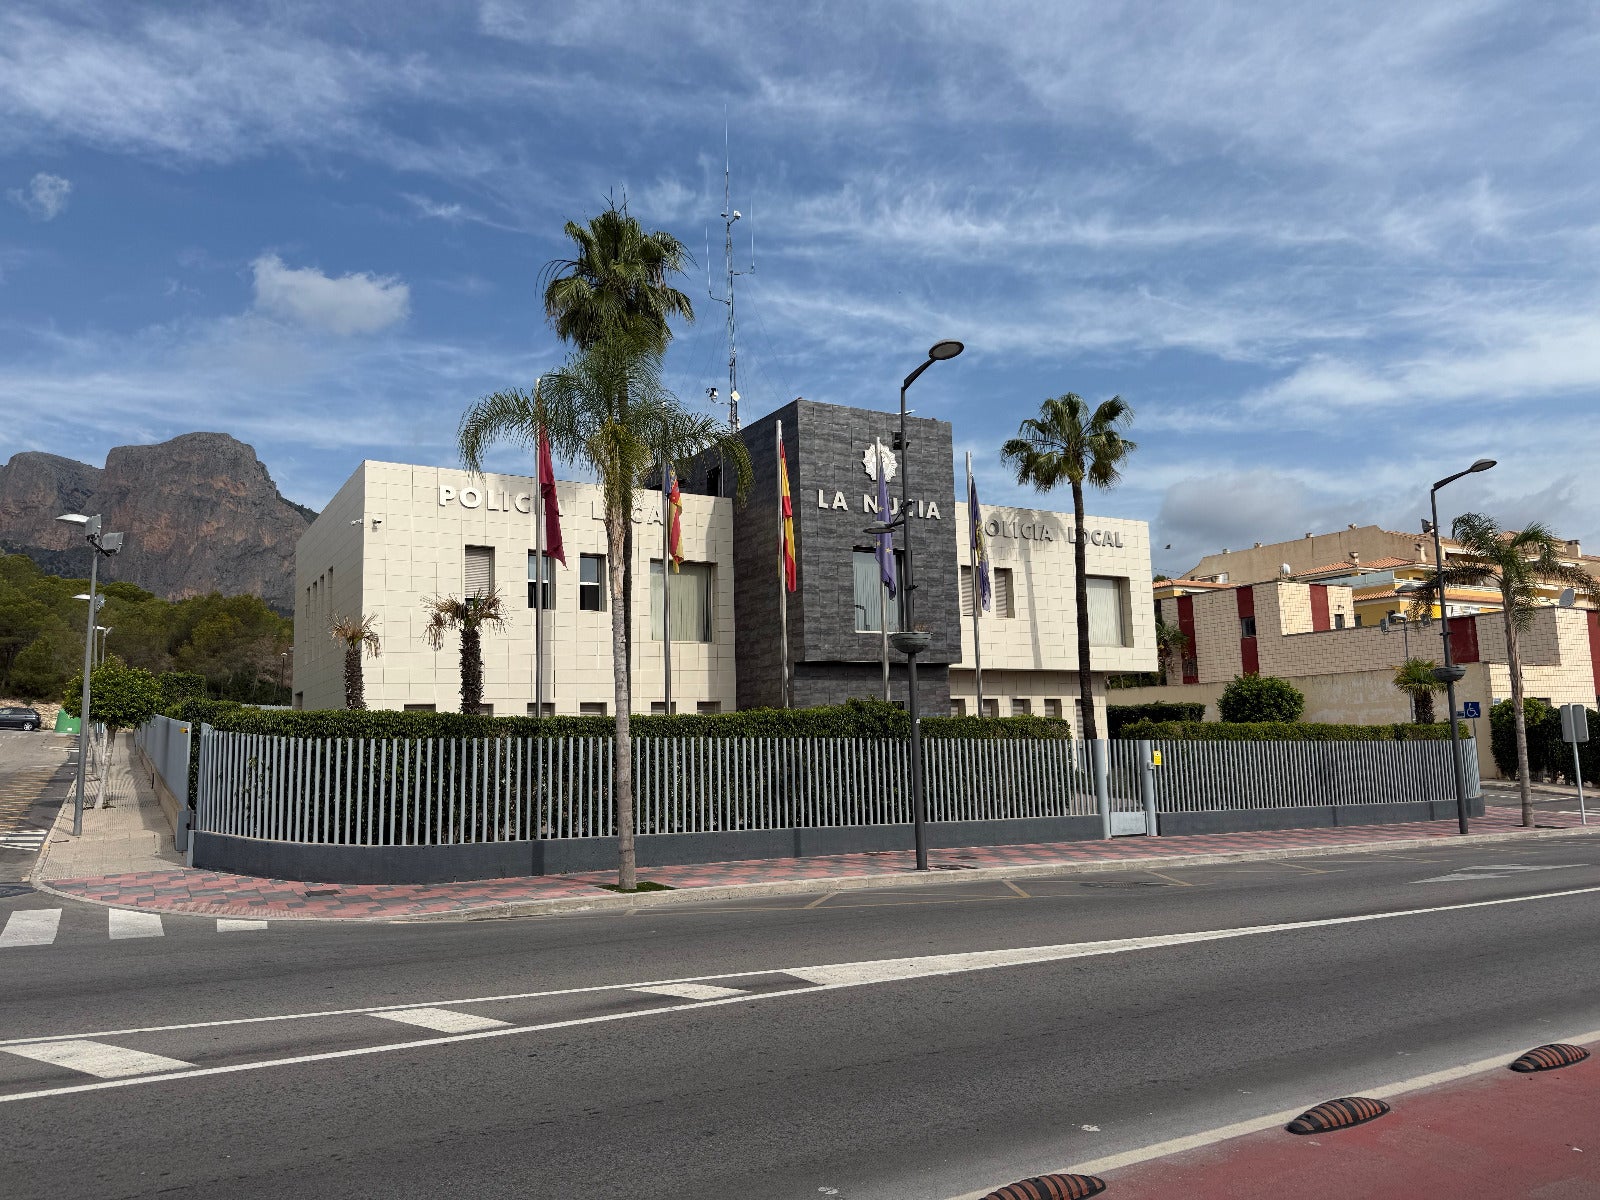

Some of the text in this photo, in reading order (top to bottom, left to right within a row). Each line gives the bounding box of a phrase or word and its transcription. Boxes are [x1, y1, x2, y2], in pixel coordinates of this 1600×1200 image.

[438, 484, 563, 517] POLIC
[818, 489, 849, 511] LA
[985, 519, 1053, 542] OLICIA
